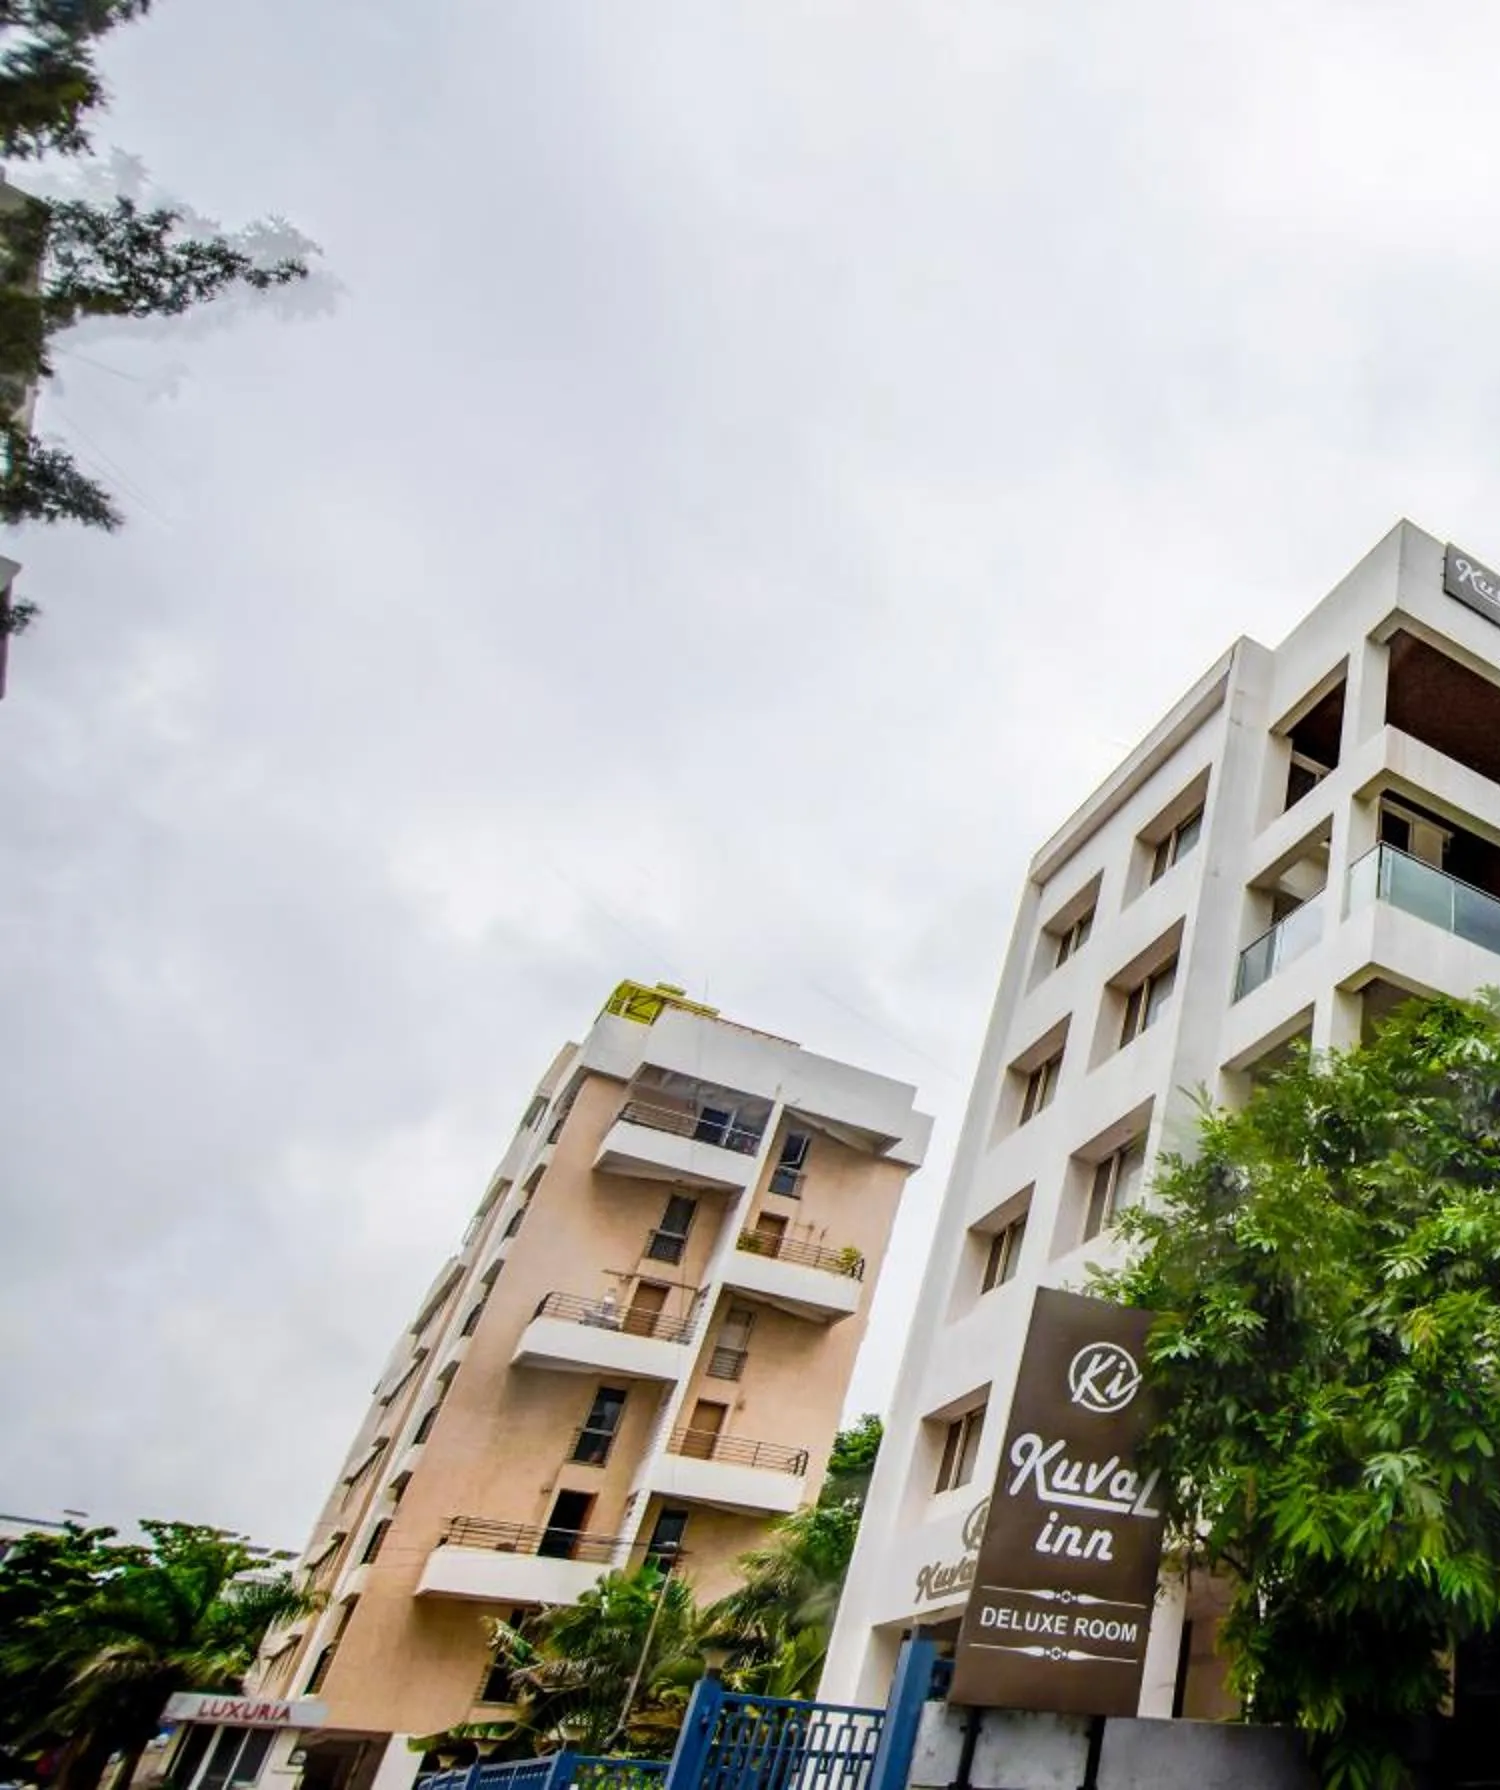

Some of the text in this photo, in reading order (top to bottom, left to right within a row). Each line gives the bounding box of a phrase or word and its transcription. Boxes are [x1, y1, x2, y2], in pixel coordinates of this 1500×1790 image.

[1035, 1511, 1114, 1562] inn
[913, 1555, 977, 1604] Kuva
[980, 1606, 1139, 1644] DELUXE ROOM
[196, 1699, 292, 1722] LUXURIA
